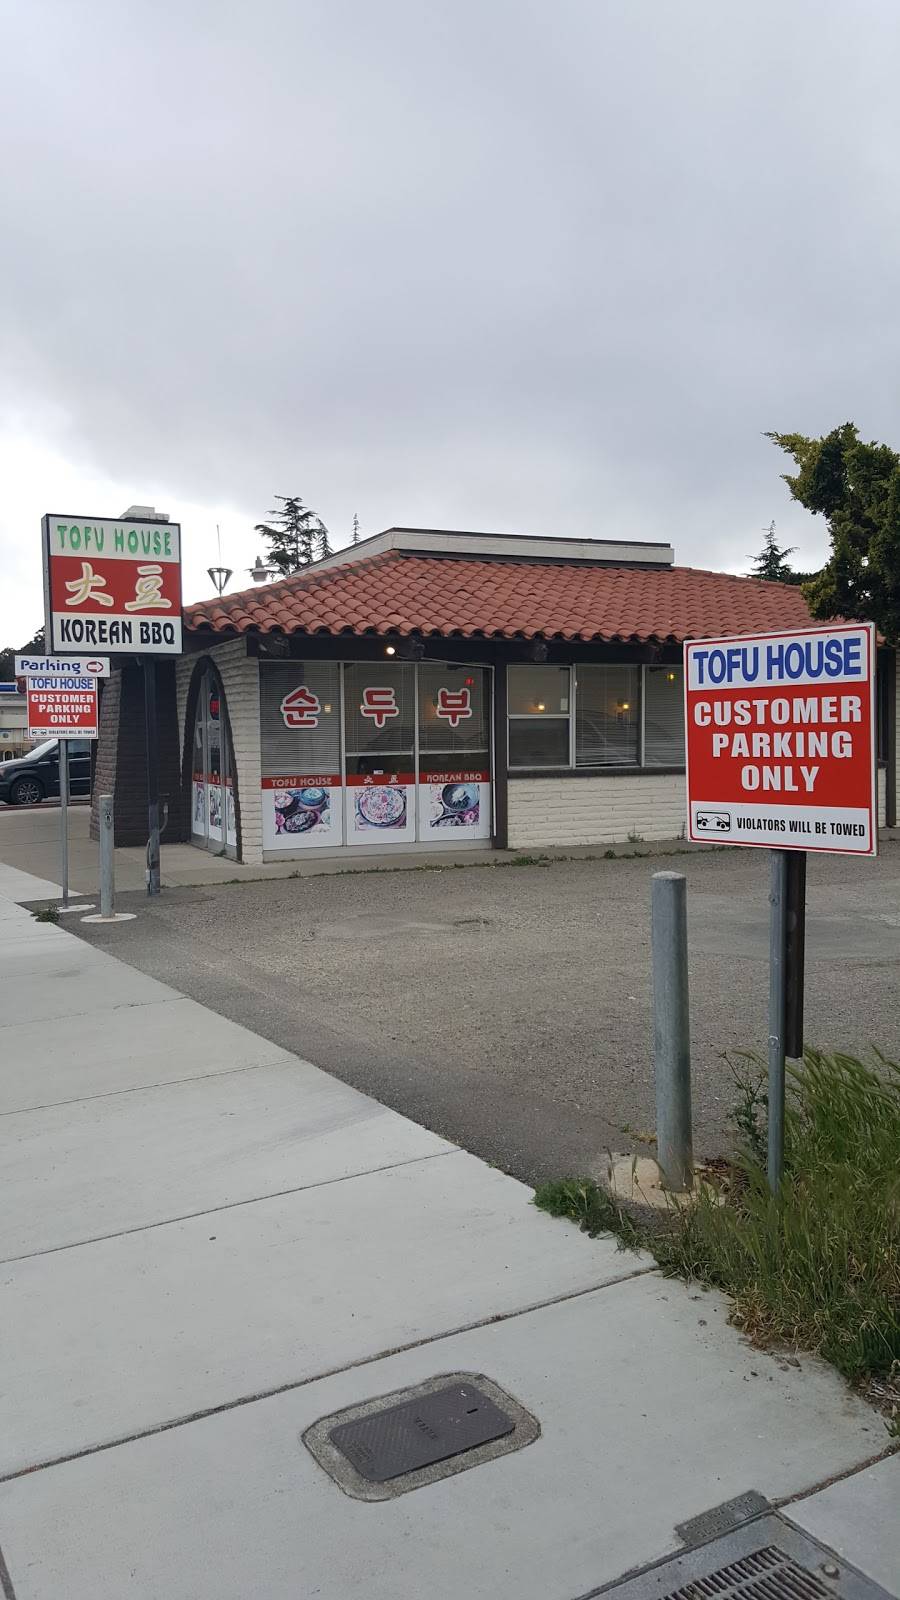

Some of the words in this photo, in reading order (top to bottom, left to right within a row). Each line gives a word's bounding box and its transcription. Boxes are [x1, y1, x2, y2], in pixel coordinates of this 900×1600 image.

[57, 525, 105, 552] TOFU
[114, 527, 172, 556] HOUSE
[65, 561, 172, 612] 大豆
[60, 618, 133, 646] KOREAN
[140, 621, 175, 645] BBQ
[20, 659, 81, 674] Parking
[692, 646, 759, 684] TOFU
[766, 637, 861, 681] HOUSE
[31, 677, 57, 689] TOFU
[60, 678, 94, 690] HOUSE
[31, 693, 94, 703] CUSTOMER
[38, 704, 91, 714] PARKING
[50, 714, 80, 724] ONLY
[694, 696, 862, 727] CUSTOMER
[712, 730, 853, 758] PARKING
[272, 778, 297, 787] TOFU
[300, 776, 332, 786] HOUSE
[741, 764, 820, 792] ONLY
[736, 817, 786, 832] VIOLATORS
[789, 820, 811, 834] WILL
[815, 822, 827, 834] BE
[830, 822, 865, 837] TOWED
